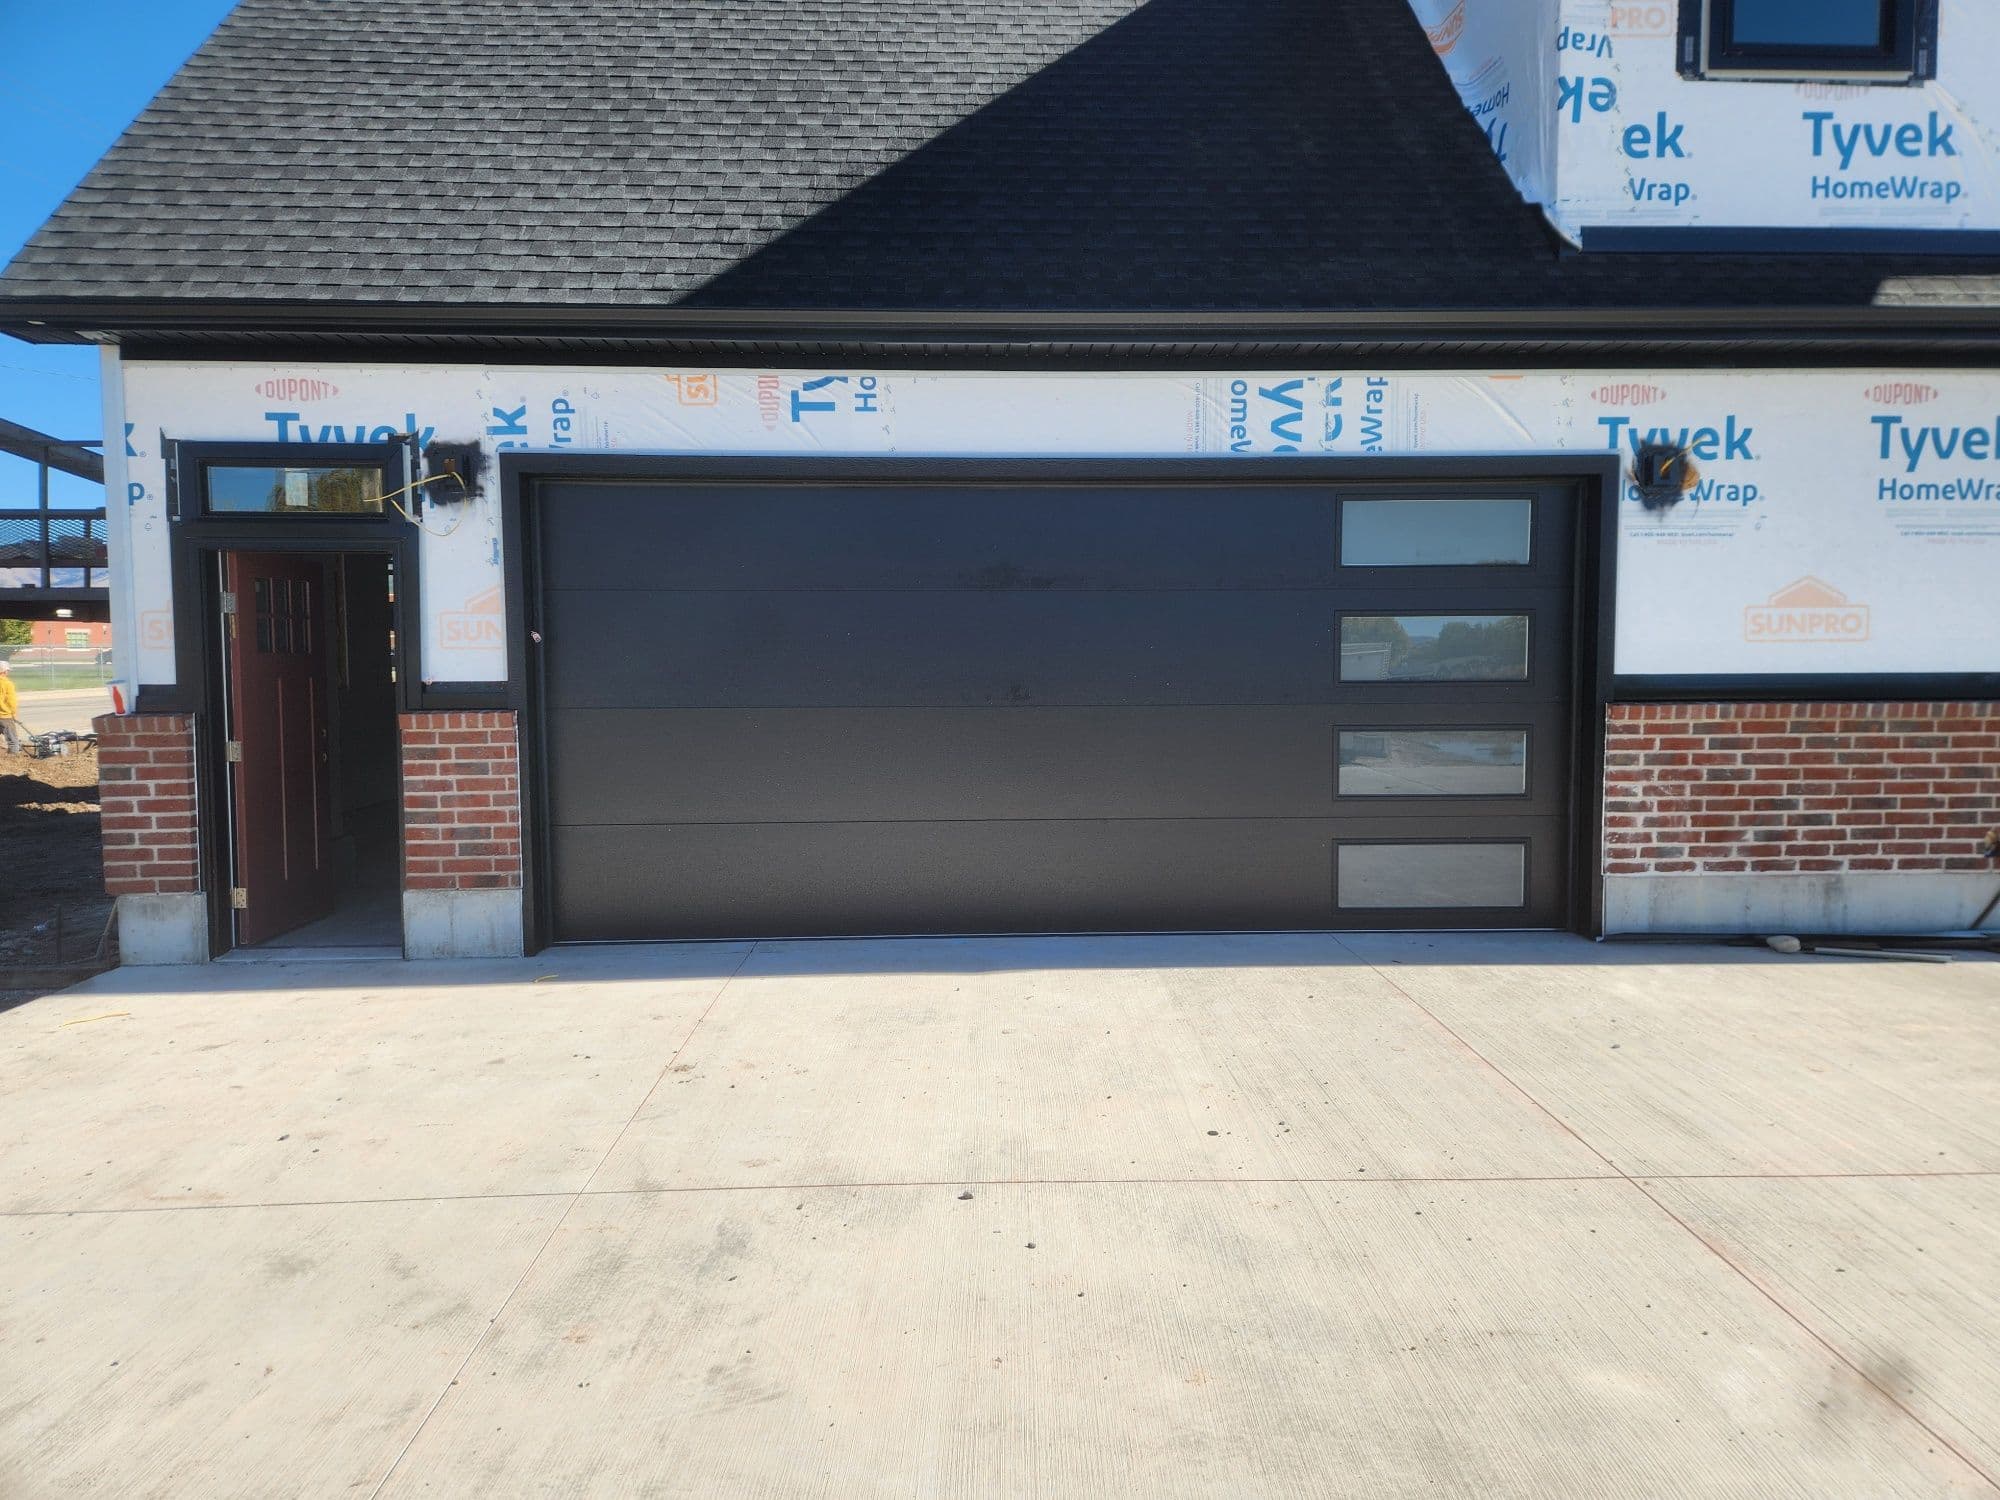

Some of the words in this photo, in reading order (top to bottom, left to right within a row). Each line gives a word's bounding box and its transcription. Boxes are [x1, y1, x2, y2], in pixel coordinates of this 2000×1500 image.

[1802, 111, 1957, 170] Tyvek
[1811, 176, 1961, 204] HomeWrap
[264, 379, 330, 402] DUPONT
[757, 375, 781, 421] DUPO
[1600, 384, 1659, 406] DUPONT
[1873, 383, 1932, 405] DUPONT
[1750, 612, 1863, 635] SUNPRO
